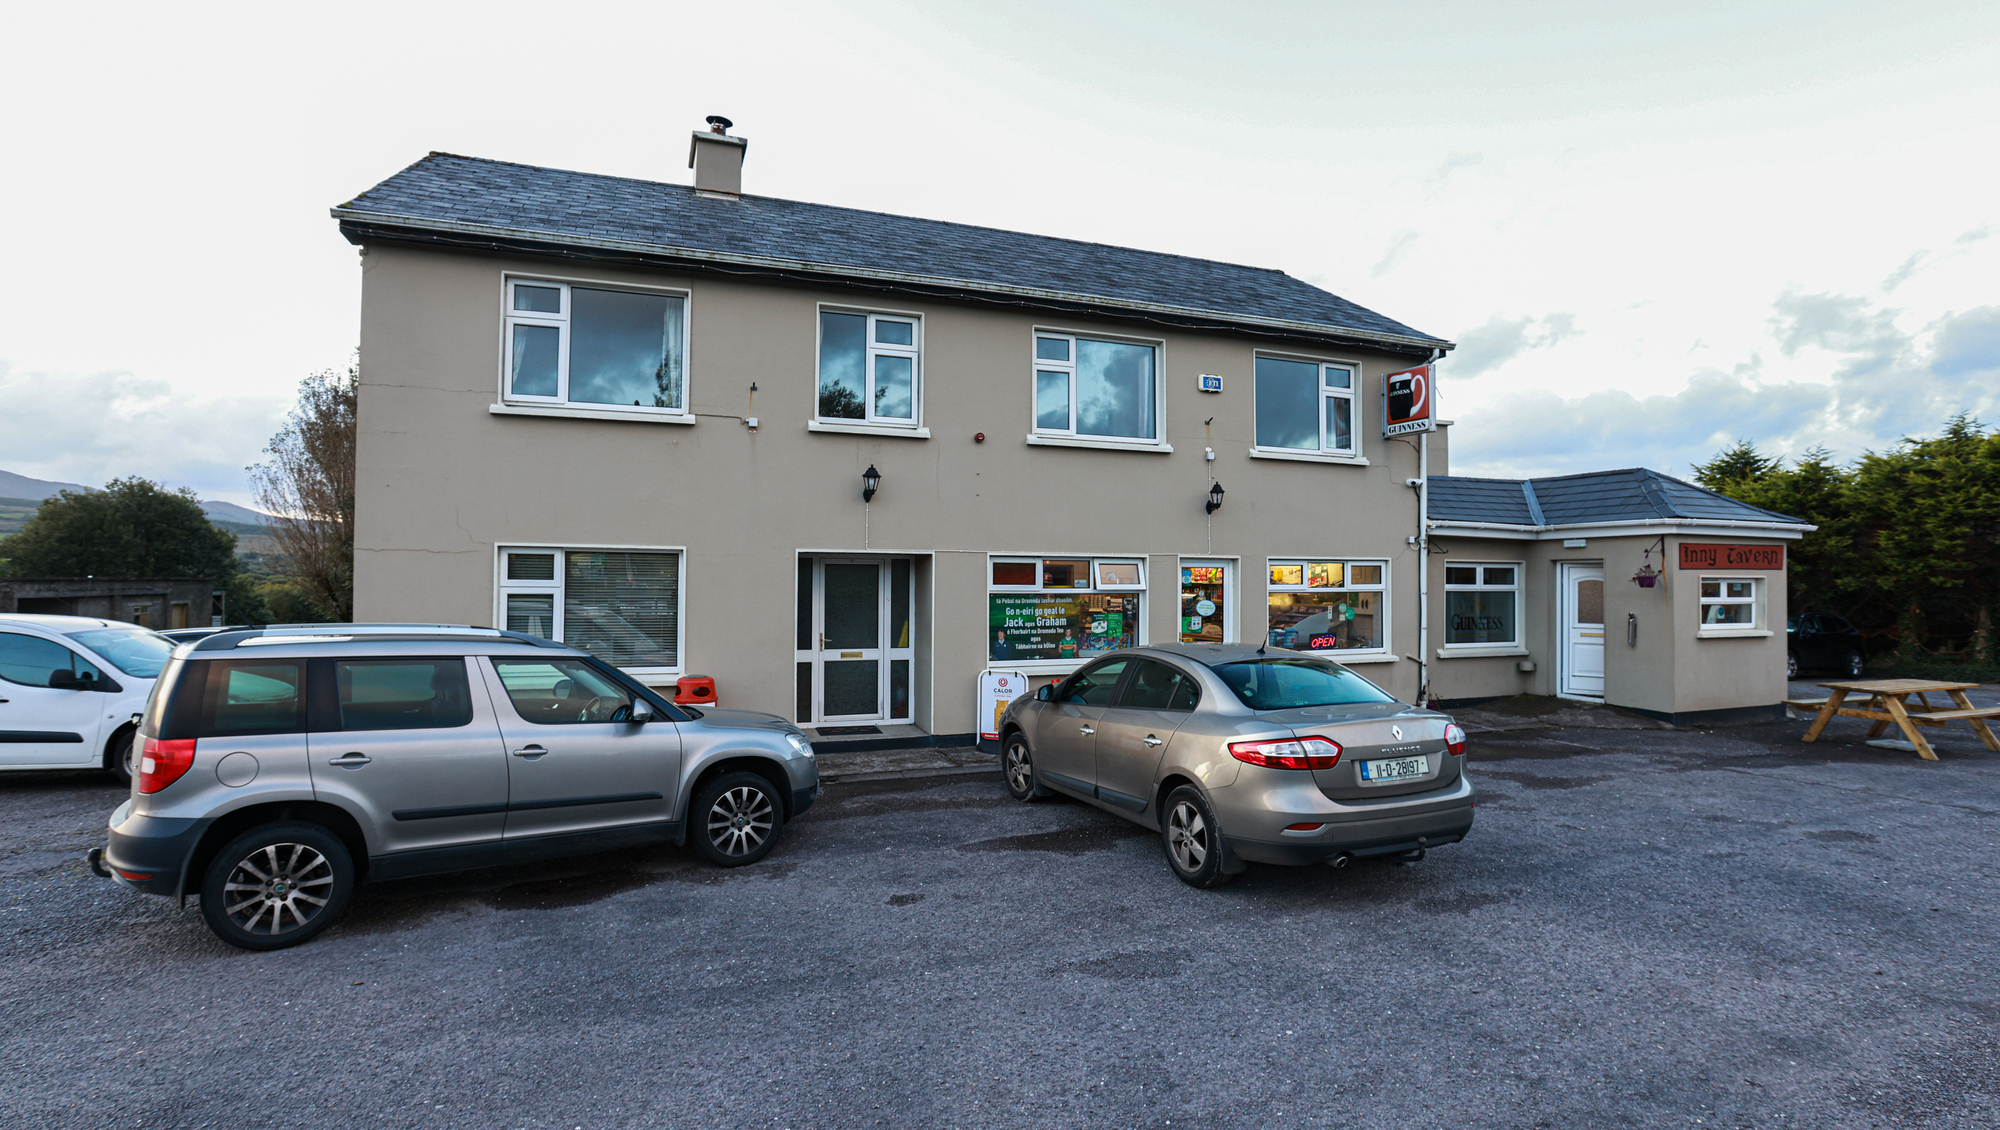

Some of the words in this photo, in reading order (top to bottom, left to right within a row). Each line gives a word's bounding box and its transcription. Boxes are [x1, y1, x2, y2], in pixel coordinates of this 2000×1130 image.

[1388, 421, 1425, 433] GUINNESS
[1683, 546, 1717, 566] Inny
[1727, 548, 1778, 565] Tavern
[1006, 607, 1014, 616] Go
[1016, 607, 1034, 615] n-eirí
[1044, 607, 1058, 616] geal
[1059, 606, 1065, 614] le
[1004, 617, 1024, 627] Jack
[1036, 617, 1067, 627] Graham
[1310, 636, 1336, 648] OPEN
[1381, 746, 1421, 754] FLUENCE
[1376, 760, 1418, 777] 11-D-28197
